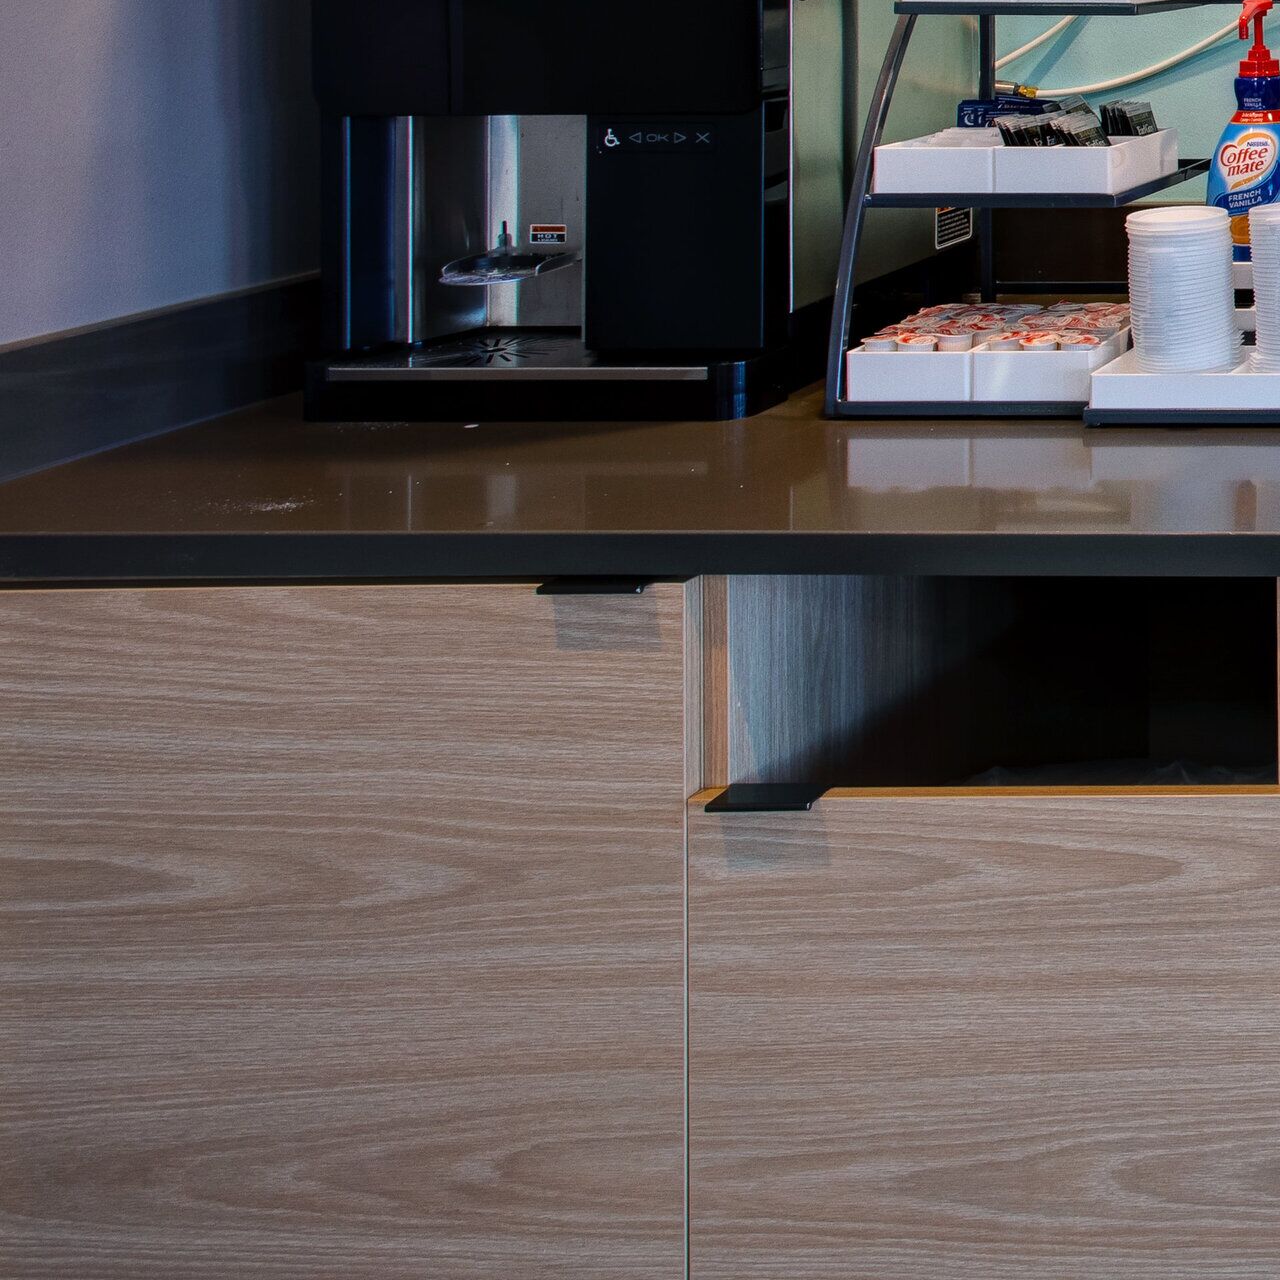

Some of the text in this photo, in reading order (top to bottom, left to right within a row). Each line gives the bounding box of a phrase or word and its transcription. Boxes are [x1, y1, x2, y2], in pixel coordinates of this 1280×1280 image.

[1220, 144, 1268, 167] Coffee
[1227, 160, 1264, 177] mate
[1228, 188, 1262, 202] FRENCH
[1229, 196, 1263, 208] VANILLA
